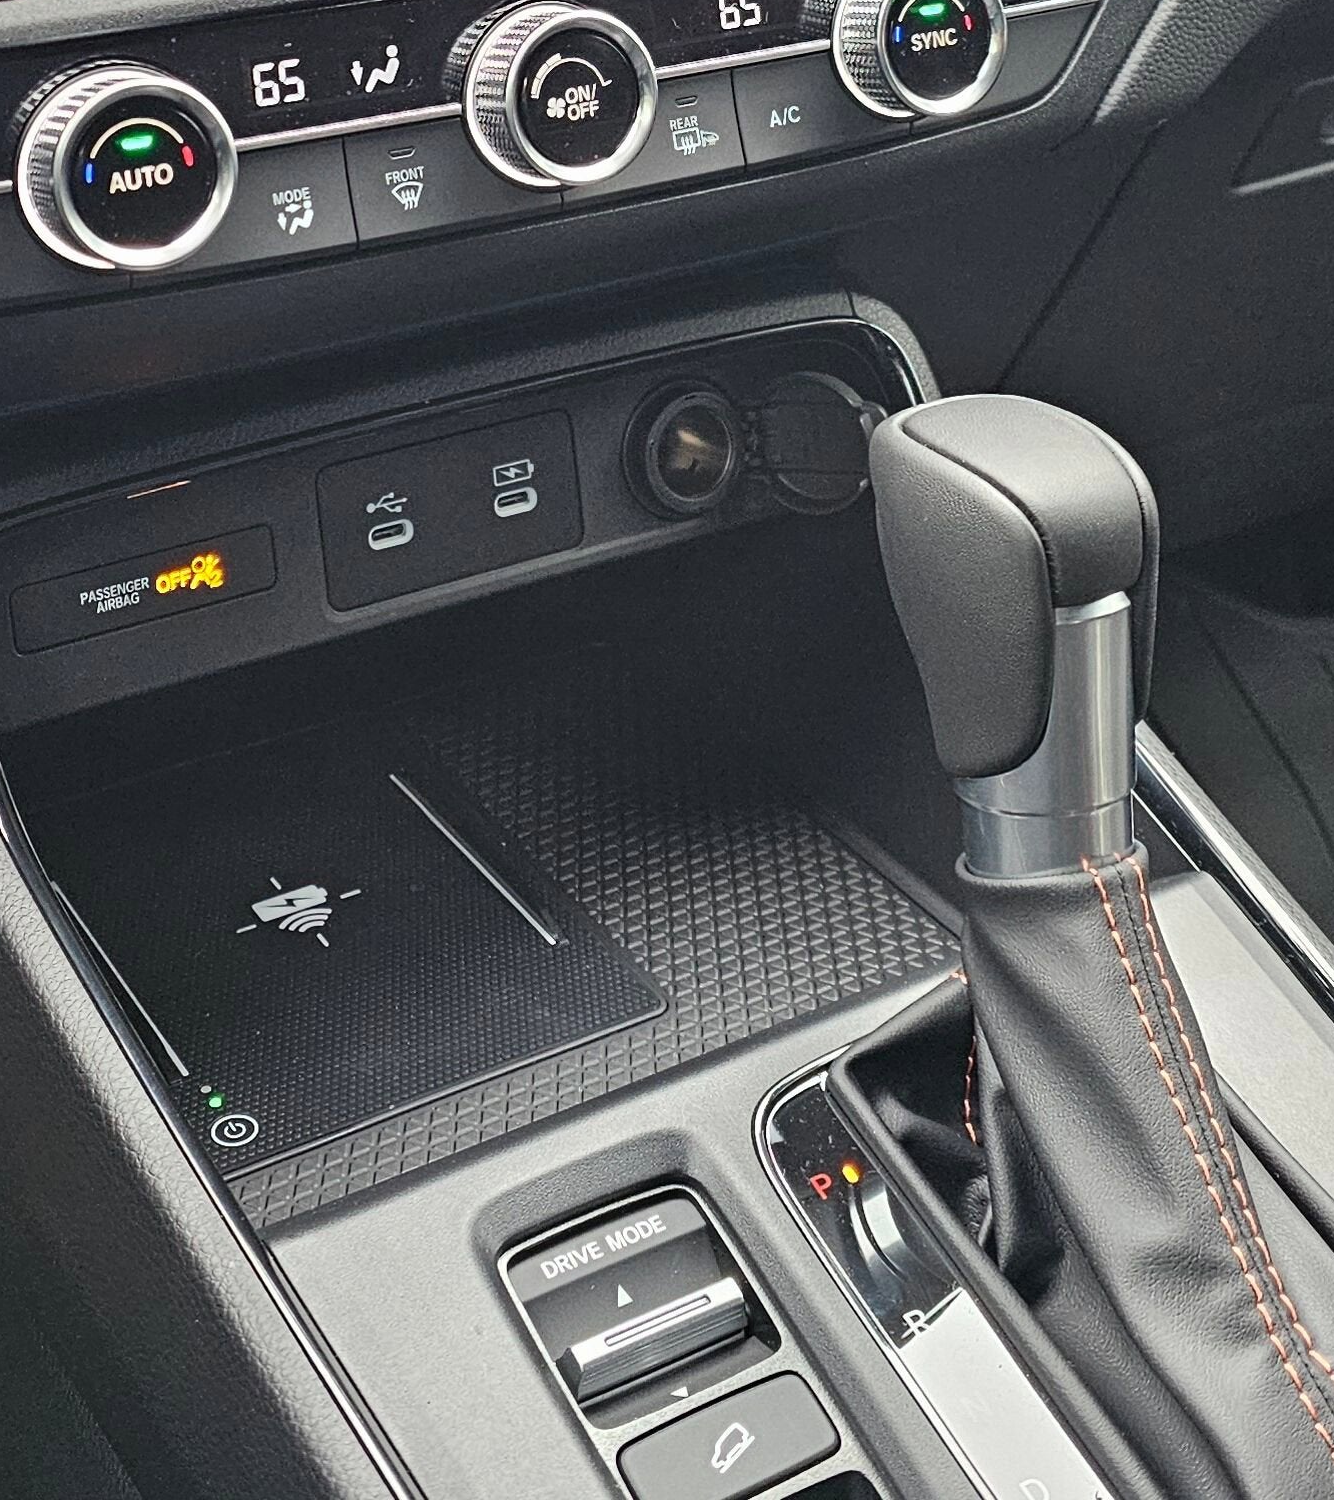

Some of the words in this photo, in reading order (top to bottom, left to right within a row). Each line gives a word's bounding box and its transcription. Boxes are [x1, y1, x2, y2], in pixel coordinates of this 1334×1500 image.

[910, 27, 959, 52] SYNC
[252, 58, 306, 107] 65
[564, 83, 597, 103] ON/
[566, 100, 599, 121] OFF
[770, 105, 802, 128] A/C
[669, 115, 699, 132] REAR
[108, 162, 175, 195] AUTO
[385, 165, 426, 186] FRONT
[272, 186, 312, 207] MODE
[79, 576, 150, 606] PASSENGER
[155, 566, 192, 595] OFF
[96, 592, 140, 614] AIRBAG
[809, 1173, 833, 1200] P
[540, 1241, 605, 1280] DRIVE
[604, 1214, 667, 1253] MODE
[902, 1309, 930, 1336] R
[1018, 1478, 1050, 1500] D
